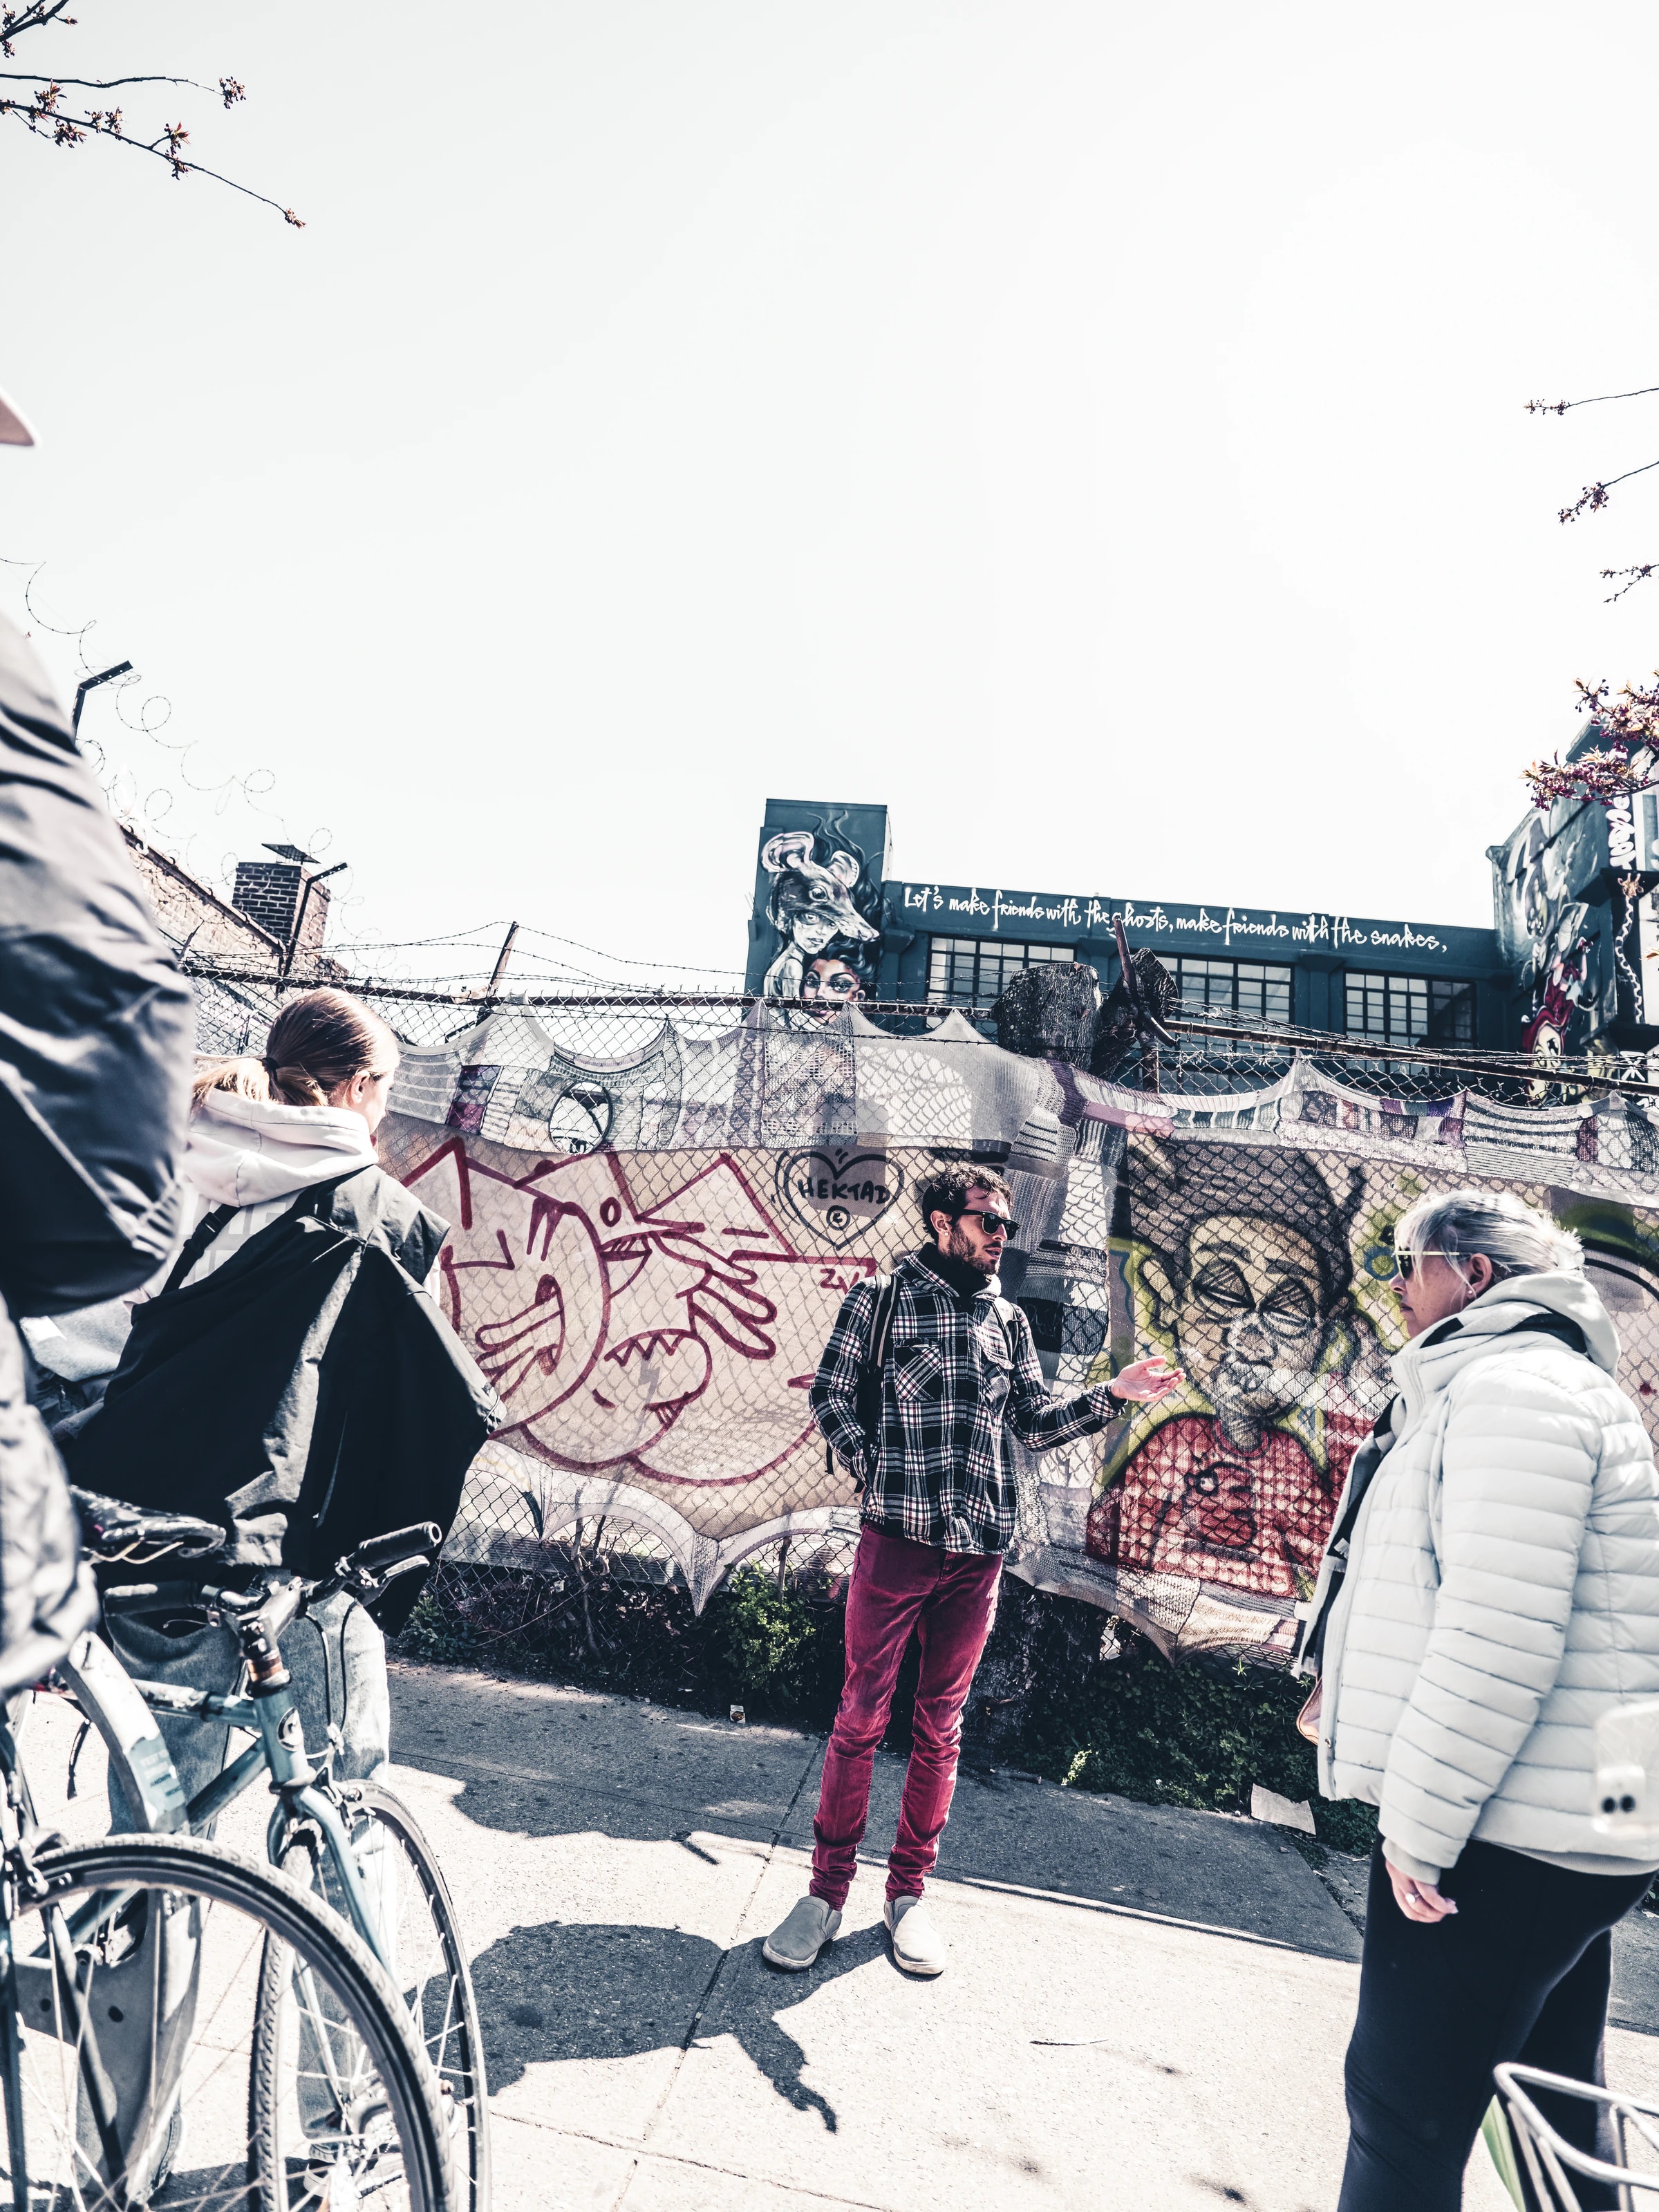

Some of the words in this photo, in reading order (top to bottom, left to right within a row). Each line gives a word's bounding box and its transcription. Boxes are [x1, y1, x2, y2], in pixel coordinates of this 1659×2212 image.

[904, 885, 944, 912] Let's
[949, 888, 991, 915] make
[991, 890, 1045, 931] friends
[1045, 899, 1082, 928] with
[1084, 900, 1110, 928] the
[1177, 908, 1223, 933] make
[1222, 907, 1289, 946] friends
[1292, 913, 1329, 943] with
[1331, 916, 1367, 949] the
[1371, 924, 1447, 953] snakes,
[797, 1177, 890, 1204] HEKTAD
